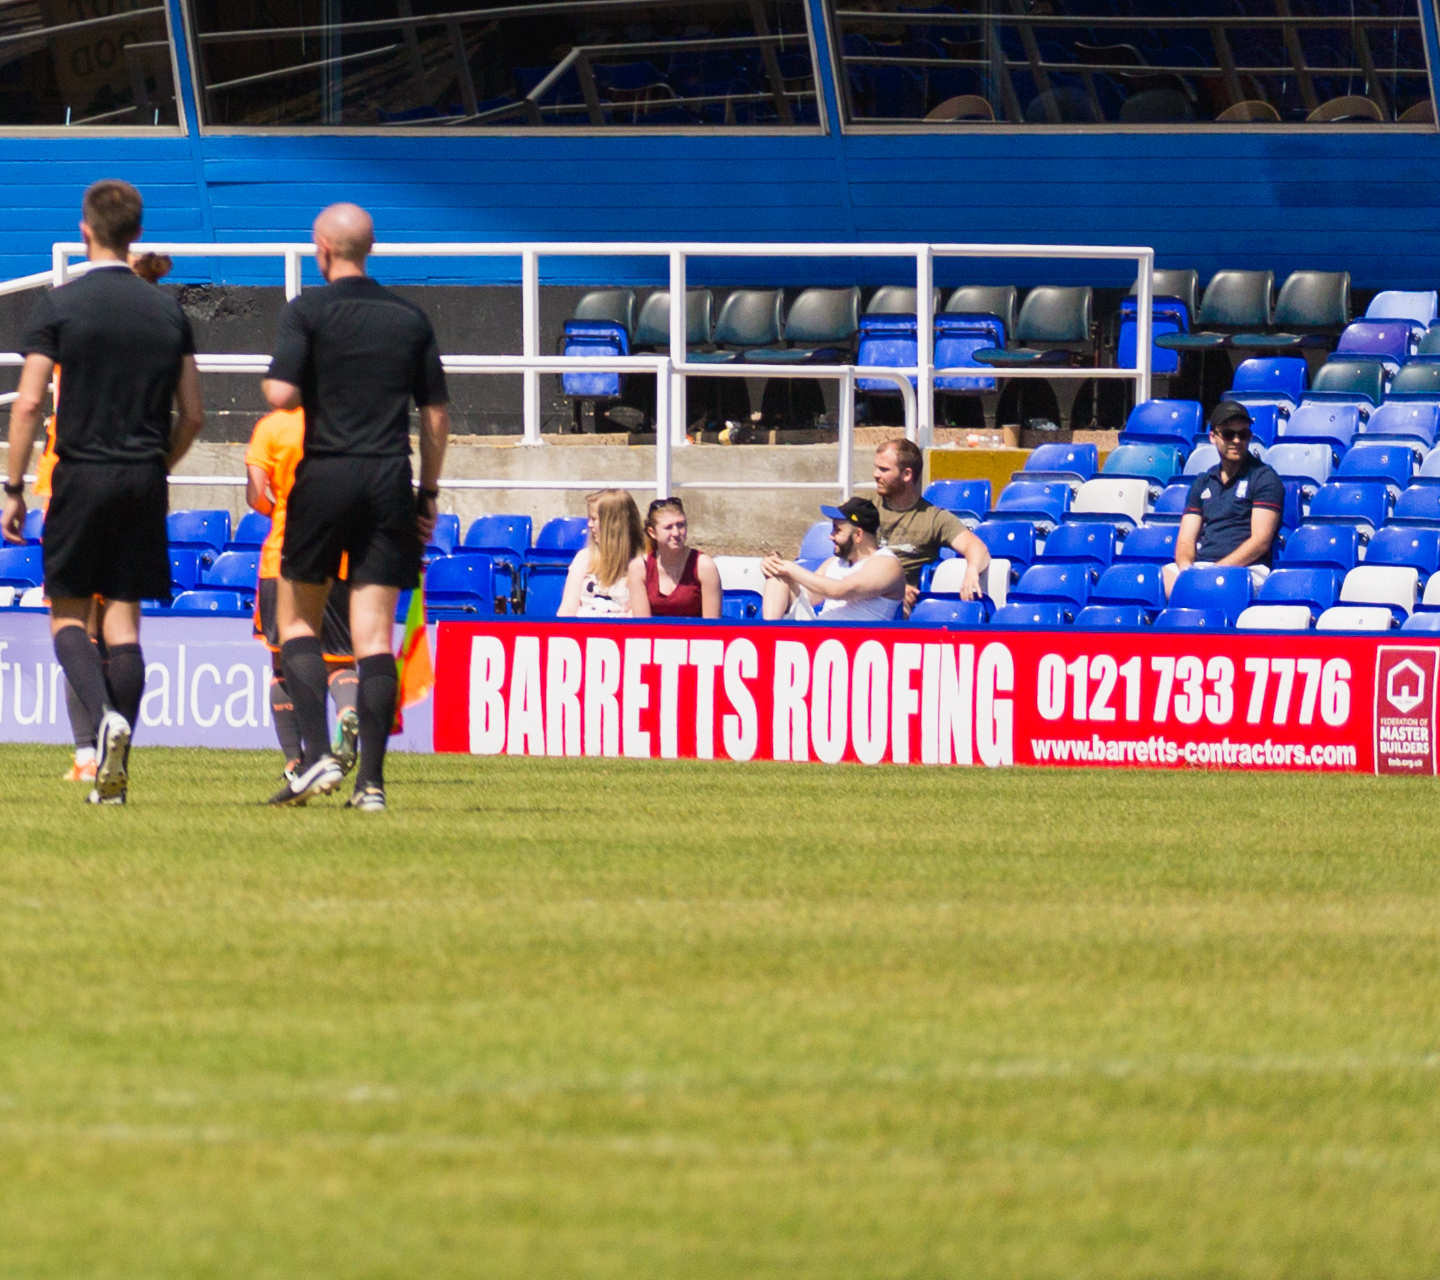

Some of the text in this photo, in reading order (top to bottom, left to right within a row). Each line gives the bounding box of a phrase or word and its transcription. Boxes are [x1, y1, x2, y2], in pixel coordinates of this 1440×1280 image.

[470, 633, 1015, 768] BARRETTS ROOFING
[1036, 653, 1353, 726] 0121 733 7776
[1380, 717, 1429, 727] FEDERATION OF
[1380, 726, 1429, 741] MASTER
[1031, 733, 1357, 767] www.barretts-contractors.com
[1380, 742, 1430, 754] BUILDERS
